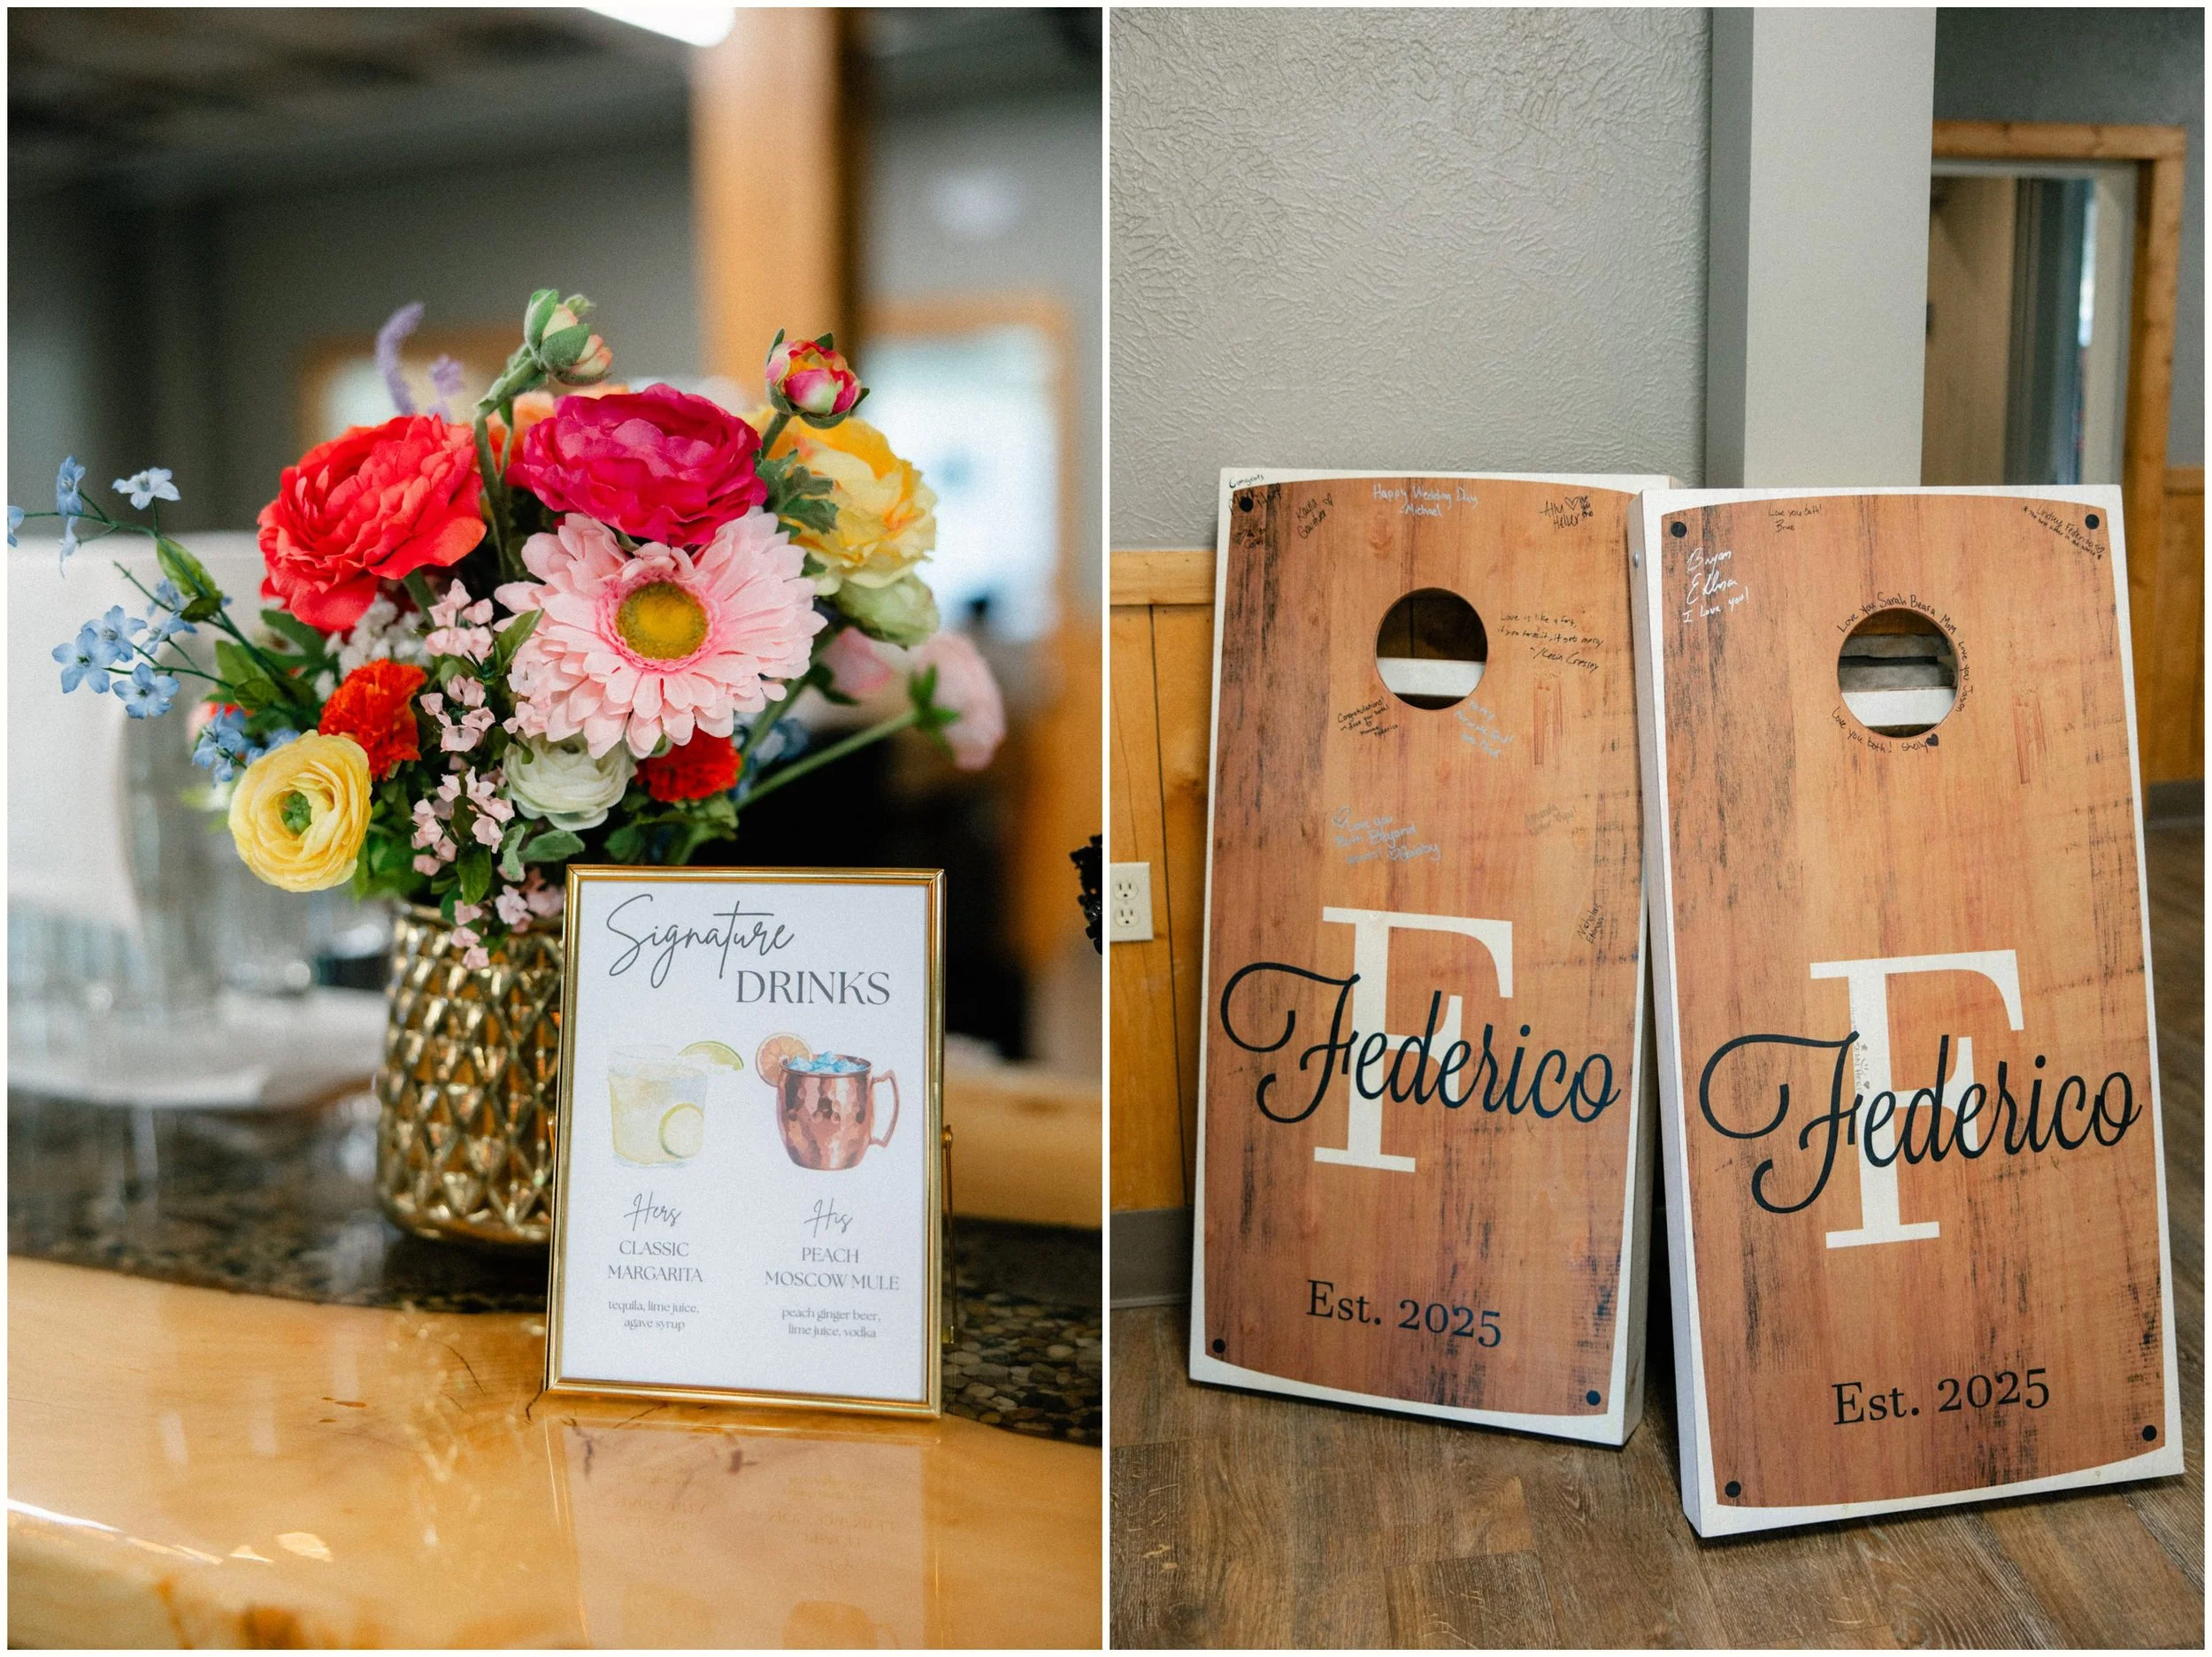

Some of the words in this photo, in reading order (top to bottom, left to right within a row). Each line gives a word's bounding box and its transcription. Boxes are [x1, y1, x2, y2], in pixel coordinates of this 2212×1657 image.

[1372, 483, 1409, 505] Happy
[1412, 485, 1452, 510] Wedding
[1455, 487, 1479, 509] Day
[1768, 502, 1785, 517] Love
[1683, 610, 1693, 623] I
[1700, 605, 1721, 618] Love
[1837, 613, 1859, 633] Love
[1859, 603, 1877, 616] you
[1877, 591, 1907, 609] Sarah
[1832, 705, 1847, 730] Love
[1847, 730, 1863, 744] you
[606, 894, 795, 988] Signature
[736, 970, 890, 1005] DRINKS
[1220, 962, 1621, 1124] Federico
[1314, 906, 1513, 1173] F
[1809, 948, 2024, 1249] F
[1699, 1030, 2143, 1214] Federico
[624, 1191, 681, 1232] Hers
[803, 1197, 853, 1238] His
[619, 1240, 689, 1256] CLASSIC
[802, 1247, 859, 1263] PEACH
[608, 1264, 703, 1282] MARGARITA
[765, 1270, 847, 1288] MOSCOW
[851, 1274, 900, 1291] MULE
[608, 1300, 645, 1313] tequila,
[648, 1300, 671, 1311] lime
[671, 1302, 700, 1315] juice,
[781, 1308, 814, 1321] peach
[816, 1309, 850, 1323] ginger
[852, 1309, 881, 1323] beer,
[1306, 1279, 1381, 1325] Est.
[1398, 1299, 1502, 1348] 2025
[624, 1319, 654, 1331] agave
[655, 1321, 685, 1332] syrup
[788, 1323, 811, 1335] lime
[812, 1325, 841, 1339] juice,
[843, 1326, 877, 1338] vodka
[1832, 1382, 1919, 1425] Est.
[1938, 1368, 2049, 1412] 2025
